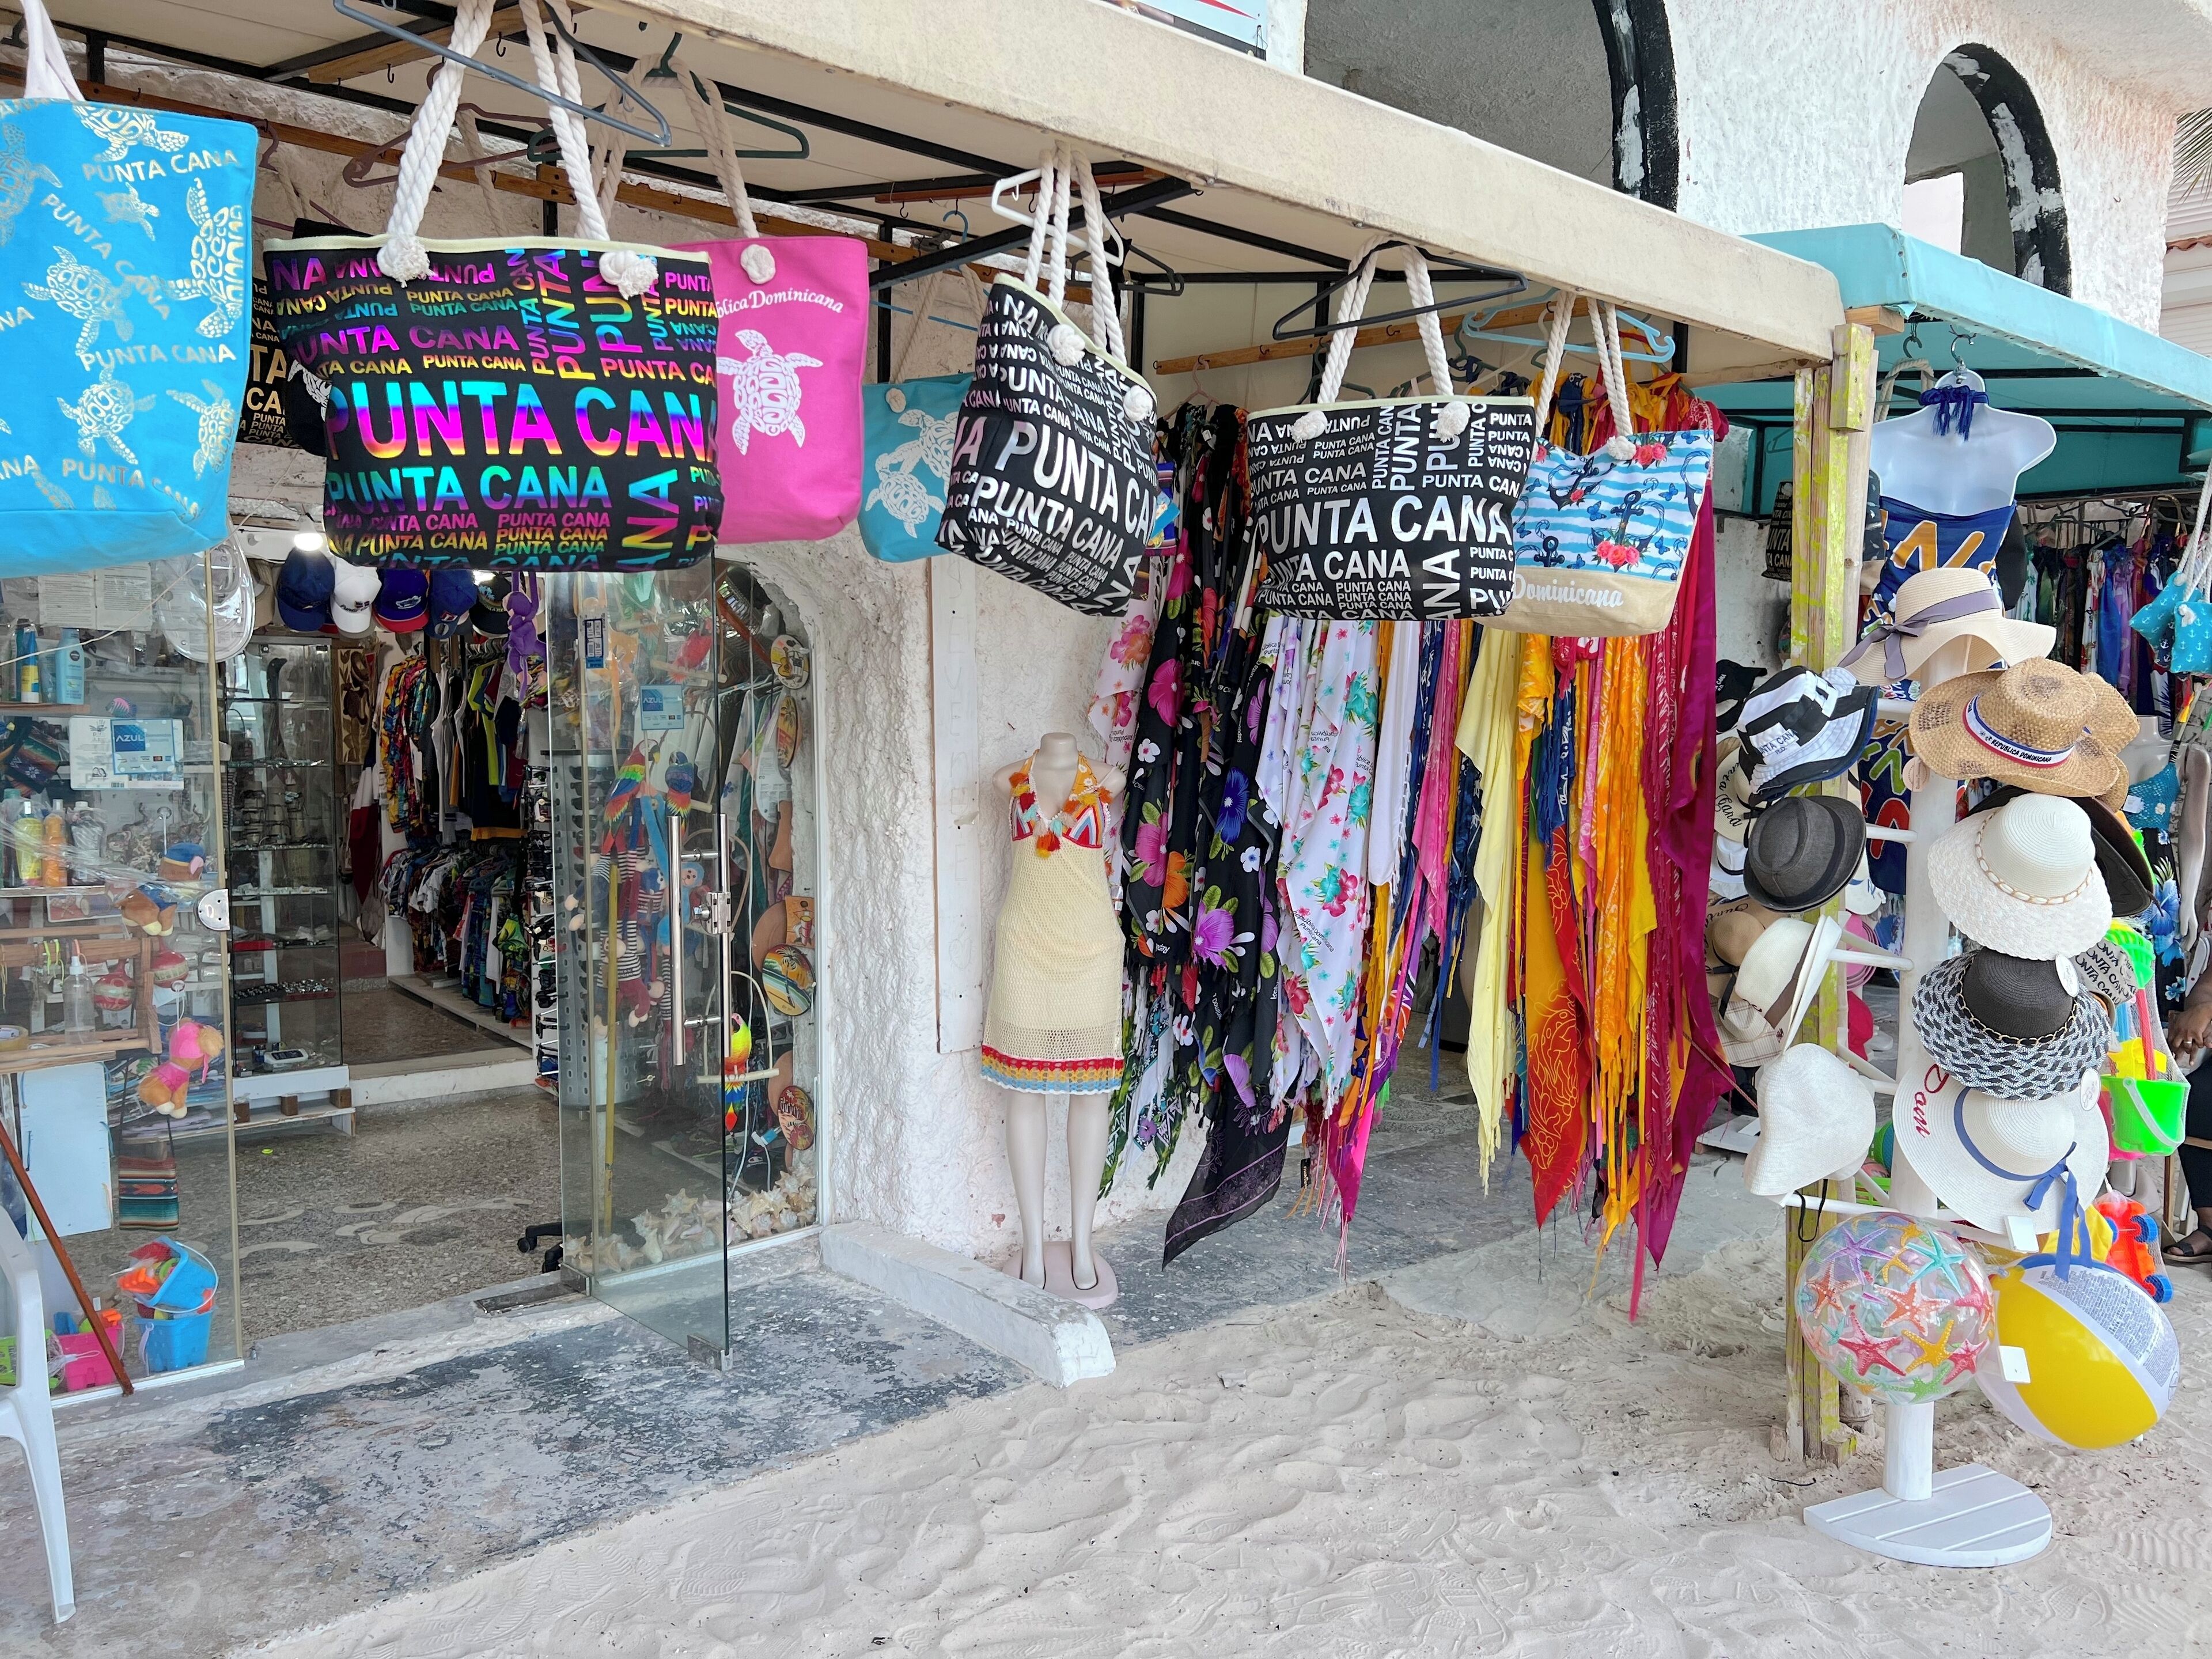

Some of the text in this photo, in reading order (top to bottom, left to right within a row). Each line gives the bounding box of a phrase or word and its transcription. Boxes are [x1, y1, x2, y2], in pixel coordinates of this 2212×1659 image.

[82, 150, 240, 183] PUNTA CANA
[40, 194, 112, 260] PUNTA
[272, 257, 328, 291] NA
[407, 287, 515, 304] PUNTA CANA
[749, 287, 844, 313] Dominicana
[410, 298, 519, 317] PUNTA CANA
[533, 249, 596, 381] PUNTA
[665, 297, 718, 318] PUNTA
[1003, 293, 1038, 333] NA
[409, 324, 520, 351] CANA
[518, 297, 555, 375] PUNTA
[79, 344, 236, 372] PUNTA CANA
[350, 358, 412, 374] CANA
[422, 355, 527, 372] PUNTA CANA
[600, 358, 687, 381] PUNTA
[1084, 387, 1106, 408] CANA
[326, 381, 563, 460] PUNTA
[1043, 403, 1071, 430] CANA
[1065, 398, 1109, 441] CANA
[1490, 413, 1533, 426] PUNTA
[1093, 433, 1111, 454] CANA
[1315, 432, 1376, 450] PUNTA CANA
[1389, 403, 1422, 491] PUNTA
[1468, 417, 1486, 467] PUNTA
[1488, 431, 1530, 442] PUNTA
[1270, 454, 1305, 467] PUNTA
[1313, 442, 1374, 459] PUNTA CANA
[1488, 445, 1524, 457] CANA
[62, 459, 145, 488] PUNTA
[994, 420, 1118, 524] PUNTA
[1305, 462, 1366, 484] CANA
[1372, 438, 1391, 489] PUNTA
[1487, 456, 1522, 472] CANA
[479, 465, 612, 510] CANA
[1307, 482, 1367, 495] PUNTA CANA
[1422, 475, 1484, 488] PUNTA
[1270, 488, 1300, 503] CANA
[425, 512, 478, 531] CANA
[498, 512, 611, 528] PUNTA CANA
[969, 475, 1125, 570] PUNTA CANA
[1258, 494, 1513, 554] PUNTA CANA
[430, 531, 488, 551] CANA
[496, 527, 608, 542] PUNTA CANA
[1006, 518, 1041, 543] PUNTA
[1041, 536, 1064, 555] CANA
[494, 541, 605, 555] PUNTA CANA
[1470, 547, 1507, 560] PUNTA
[1031, 549, 1058, 571] CANA
[1067, 551, 1109, 583] PUNTA CANA
[1324, 548, 1411, 580] CANA
[1056, 561, 1100, 592] PUNTA CANA
[1470, 567, 1507, 581] PUNTA
[1292, 582, 1324, 593] CANA
[1336, 580, 1411, 593] PUNTA CANA
[1513, 573, 1624, 607] Dominicana
[1259, 590, 1334, 607] PUNTA CANA
[1336, 592, 1412, 603] PUNTA CANA
[1339, 601, 1413, 610] PUNTA CANA
[1341, 608, 1418, 620] CANA
[1777, 730, 1797, 745] CANA
[1991, 739, 2052, 763] REPUBLICA DOMINICANA
[1715, 794, 1742, 827] Cana
[1311, 933, 1321, 945] Cana
[1315, 928, 1334, 952] Dominicana
